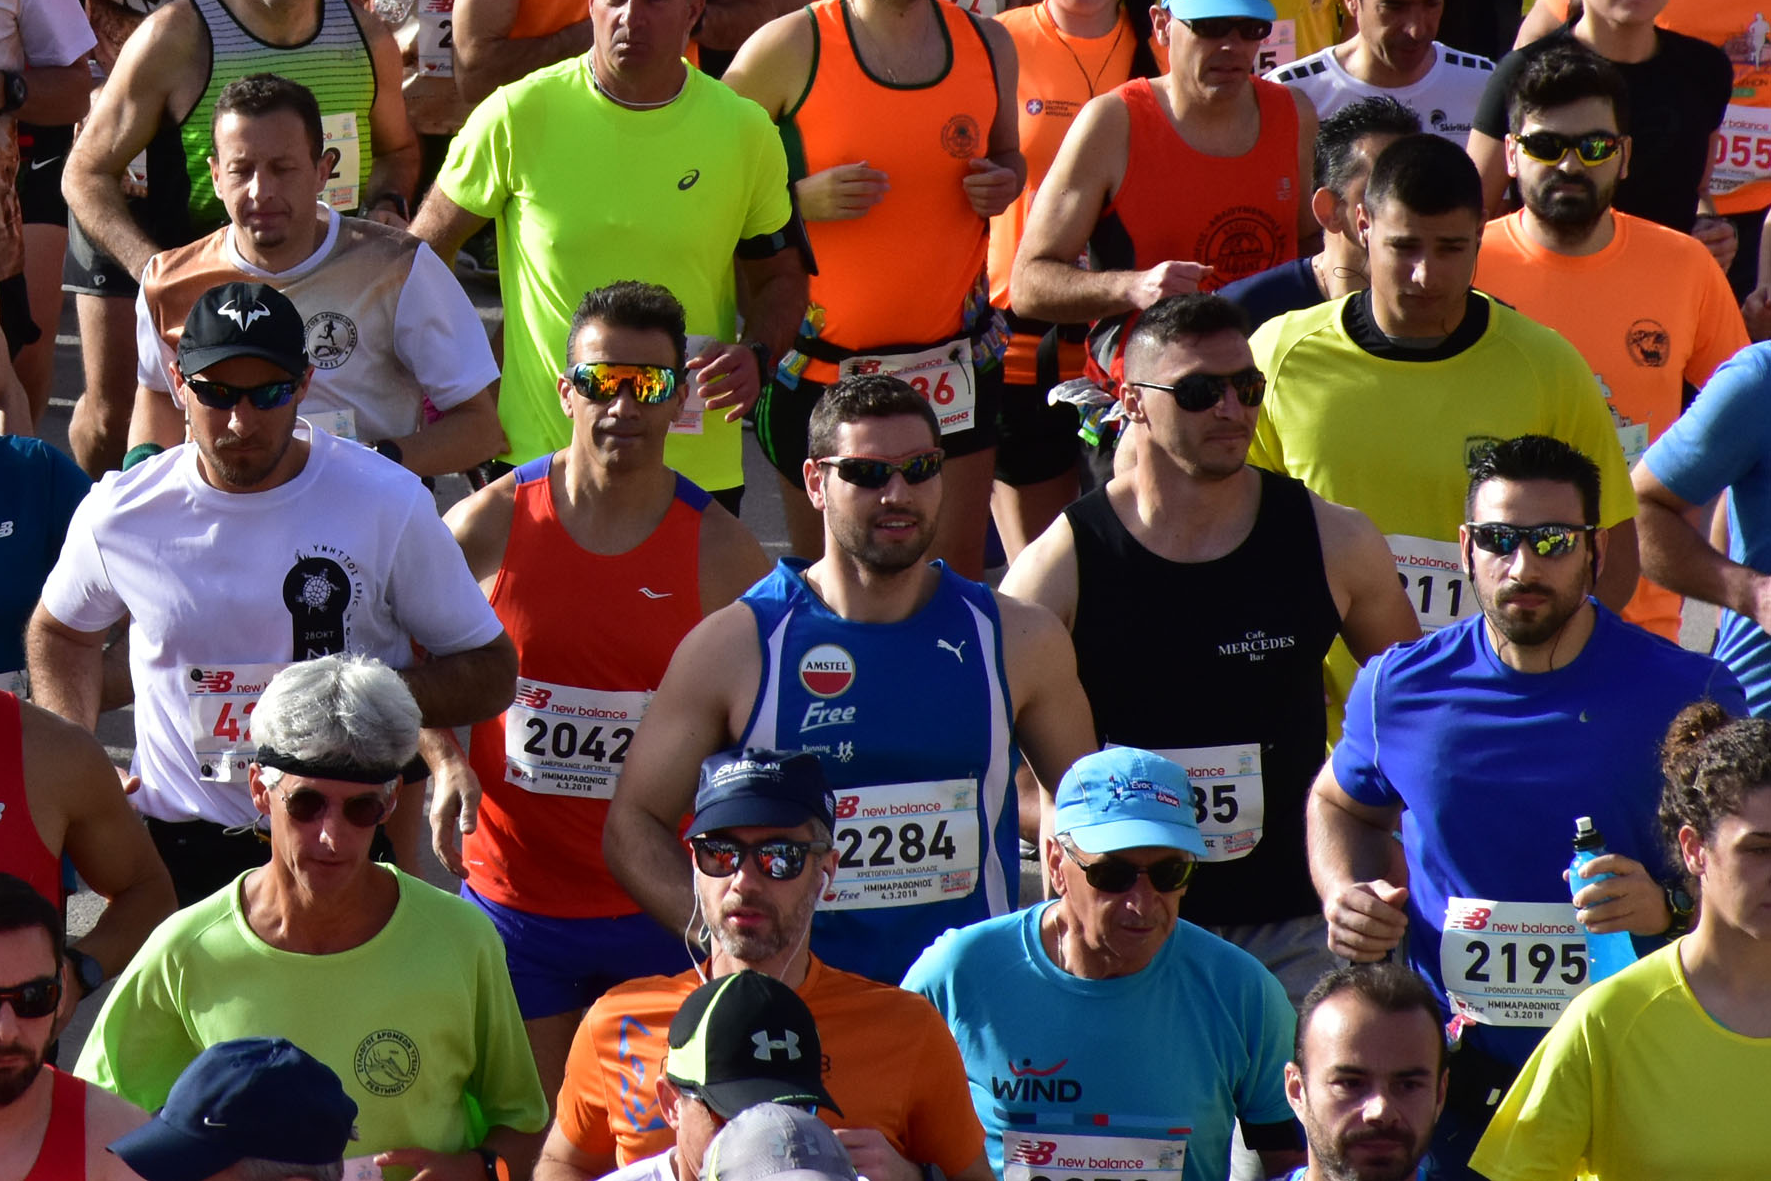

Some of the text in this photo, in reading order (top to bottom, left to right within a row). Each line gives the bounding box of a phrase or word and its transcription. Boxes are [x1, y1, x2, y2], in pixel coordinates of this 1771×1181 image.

[1729, 120, 1769, 131] balance
[1410, 555, 1459, 572] balance
[1245, 630, 1266, 641] Cafe
[1218, 636, 1296, 656] MERCEDES
[1249, 653, 1266, 661] Bar
[805, 660, 848, 672] AMSTEL
[237, 683, 262, 694] new
[551, 704, 577, 715] new
[578, 706, 628, 720] balance
[800, 701, 857, 730] Free
[524, 717, 635, 764] 2042
[802, 743, 831, 755] Running
[733, 760, 780, 773] AEGEAN
[541, 772, 608, 785] ΗΜΙΜΑΡΑΘΩΝΙΟΣ
[556, 782, 592, 792] 4.3.2018
[862, 807, 888, 818] new
[890, 802, 942, 816] balance
[837, 819, 957, 869] 2284
[906, 865, 939, 875] ΝΙΚΟΛΑΟΣ
[863, 881, 933, 894] ΗΜΙΜΑΡΑΘΩΝΙΟΣ
[836, 889, 860, 903] Free
[881, 888, 919, 901] 4.3.2018
[1492, 923, 1518, 933] new
[1522, 922, 1575, 934] balance
[1465, 940, 1588, 985] 2195
[1484, 987, 1566, 996] ΧΡΟΝΟΠΟΥΛΟΣ ΧΡΗΣΤΟΣ
[1487, 1000, 1561, 1011] ΗΜΙΜΑΡΑΘΩΝΙΟΣ
[1504, 1010, 1544, 1019] 4.3.2018
[992, 1075, 1083, 1102] WIND
[1057, 1158, 1085, 1169] new
[1088, 1156, 1145, 1170] balance
